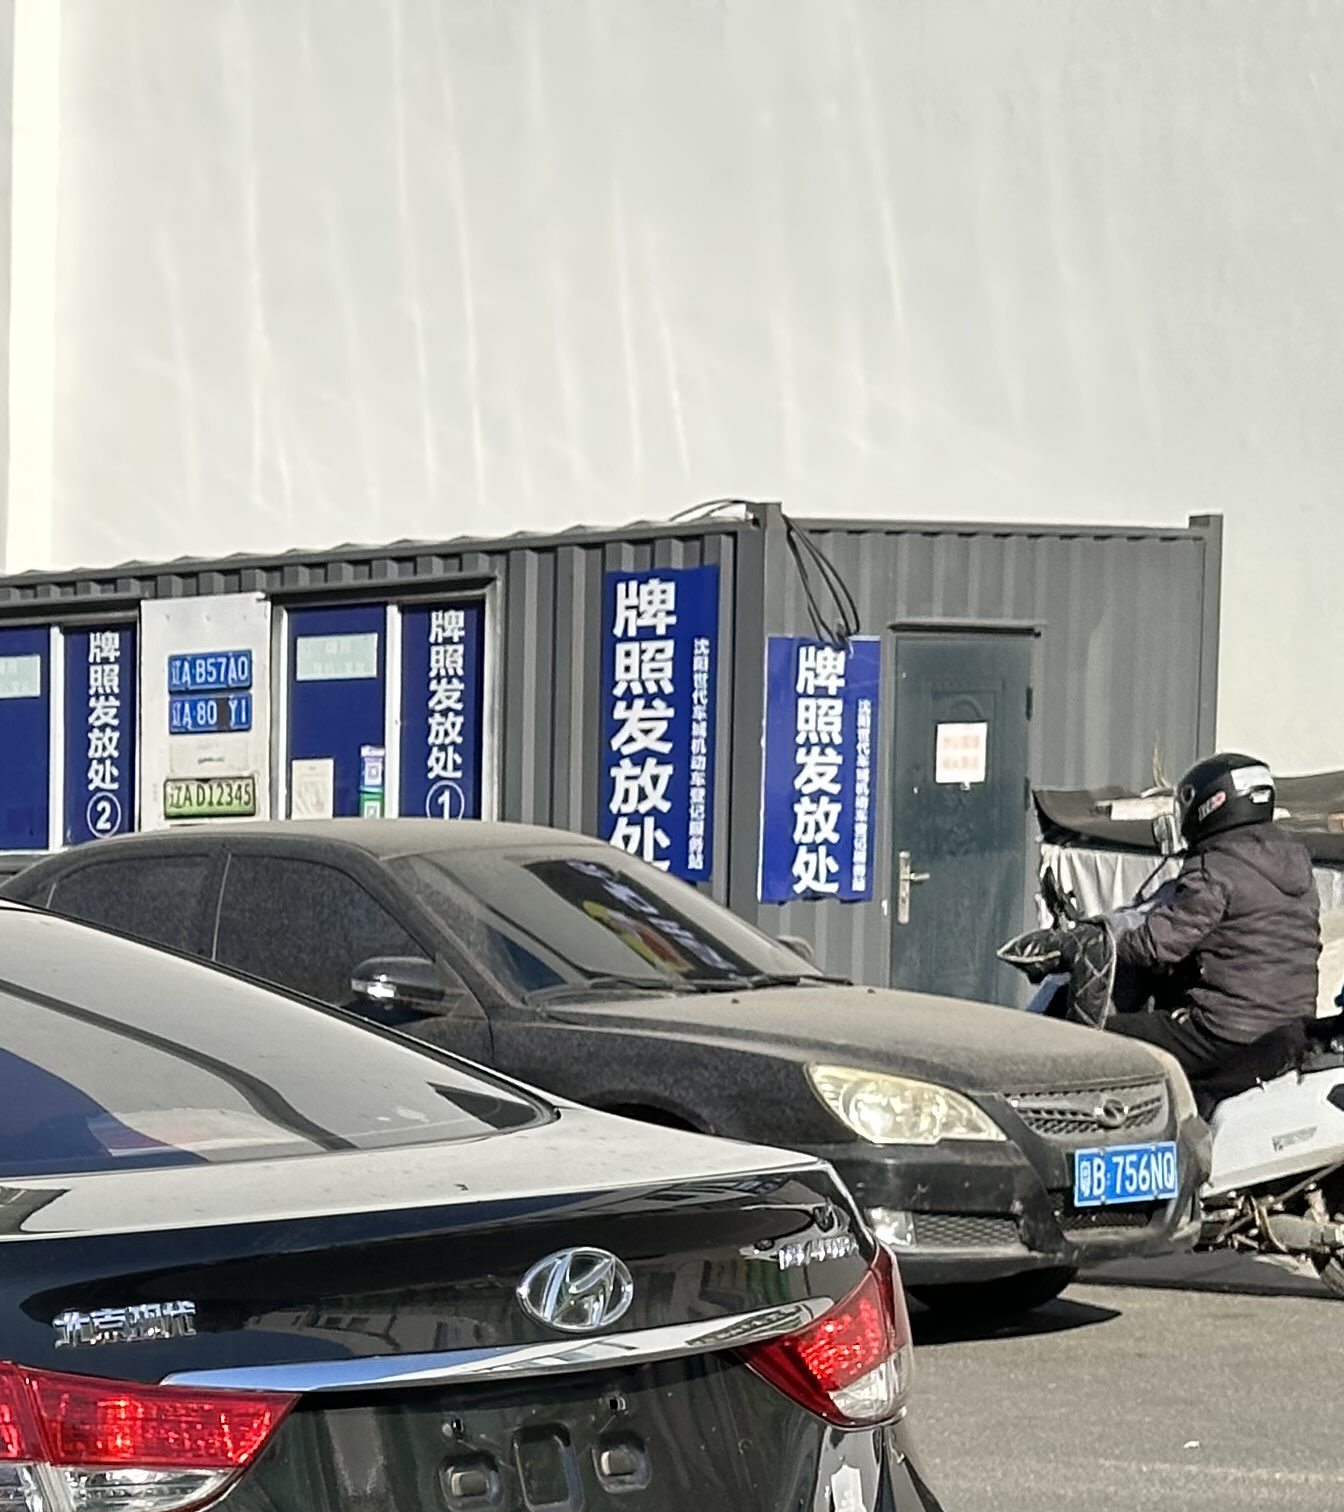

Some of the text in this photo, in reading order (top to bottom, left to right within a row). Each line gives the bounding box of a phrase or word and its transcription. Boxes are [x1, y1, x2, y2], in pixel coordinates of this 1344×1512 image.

[609, 578, 677, 872] 牌照发放处
[792, 645, 846, 894] 牌照发放处
